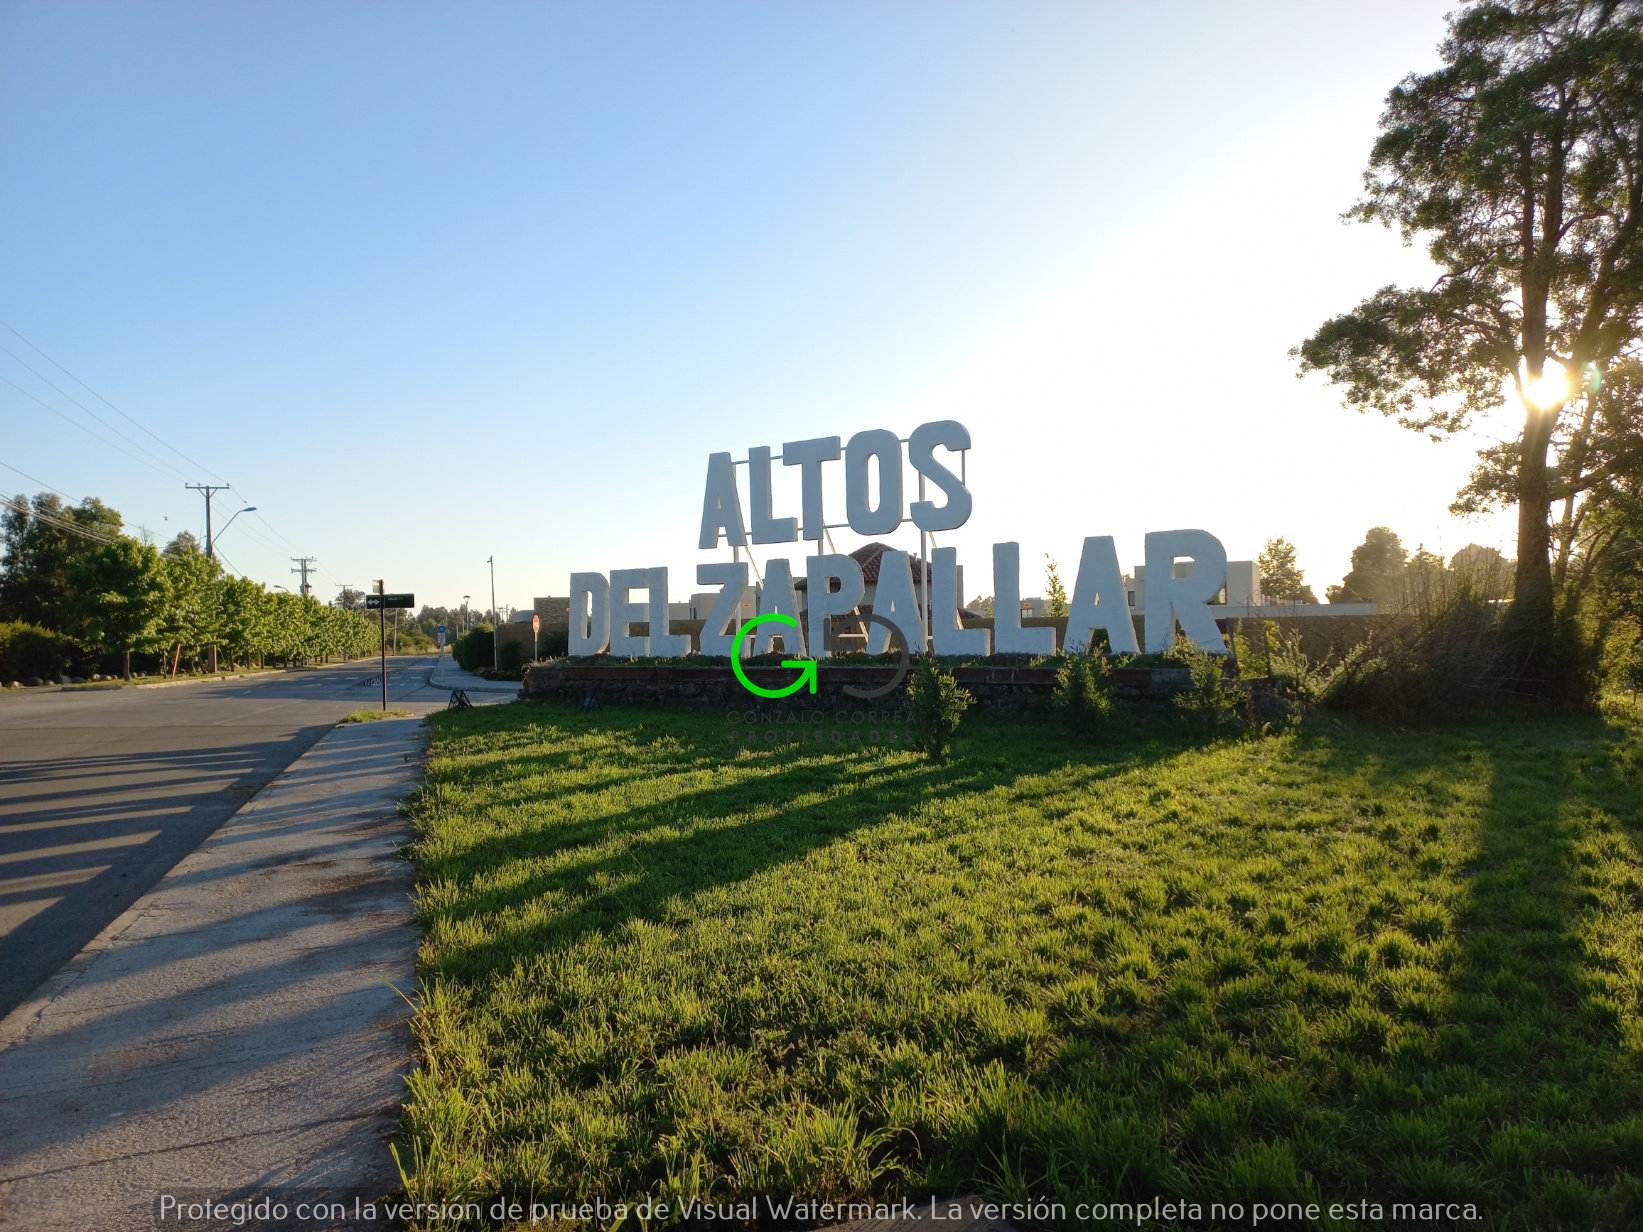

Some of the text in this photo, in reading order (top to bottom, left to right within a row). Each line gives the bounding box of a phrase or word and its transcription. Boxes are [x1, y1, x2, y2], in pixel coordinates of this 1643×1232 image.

[699, 420, 972, 549] ALTOS
[568, 528, 1228, 658] DEL ZAPALLAR
